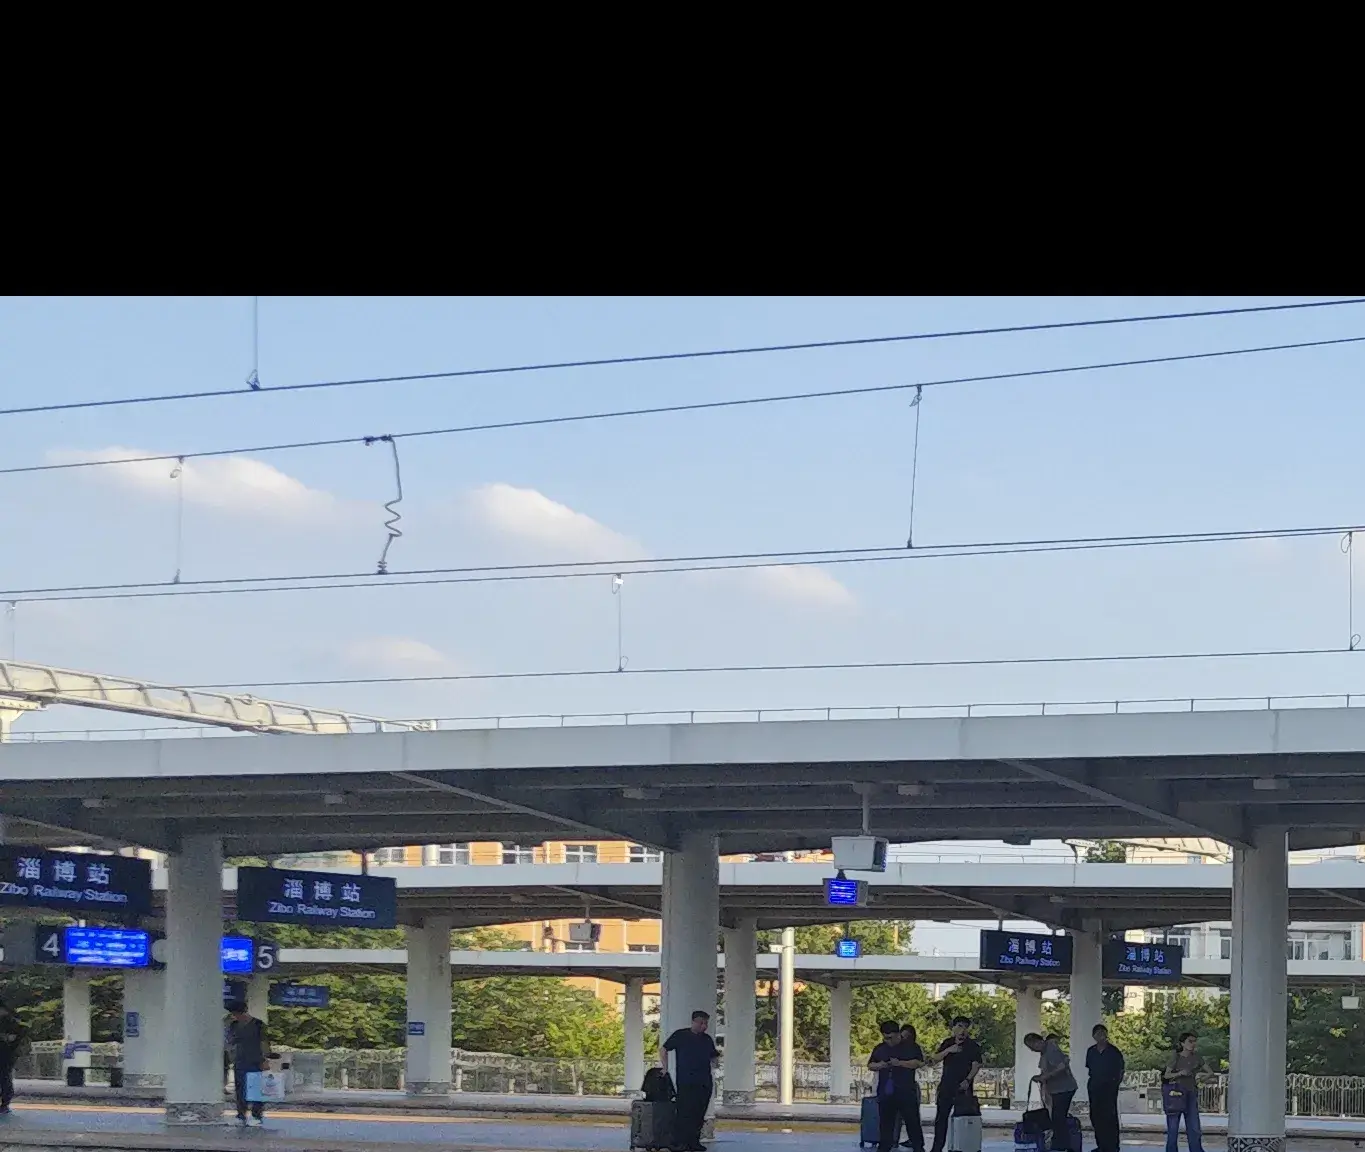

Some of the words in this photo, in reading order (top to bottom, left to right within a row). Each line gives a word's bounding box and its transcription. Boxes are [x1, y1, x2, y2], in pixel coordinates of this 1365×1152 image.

[17, 857, 111, 885] 淄博站
[0, 882, 29, 896] Zibo
[32, 884, 82, 902] Railway
[84, 888, 128, 902] Station
[283, 878, 361, 902] 淄博站
[268, 901, 294, 913] Zibo
[297, 903, 338, 918] Railway
[340, 906, 375, 919] Station
[42, 932, 60, 957] 4
[1008, 938, 1052, 955] 淄博站
[257, 946, 274, 969] 5
